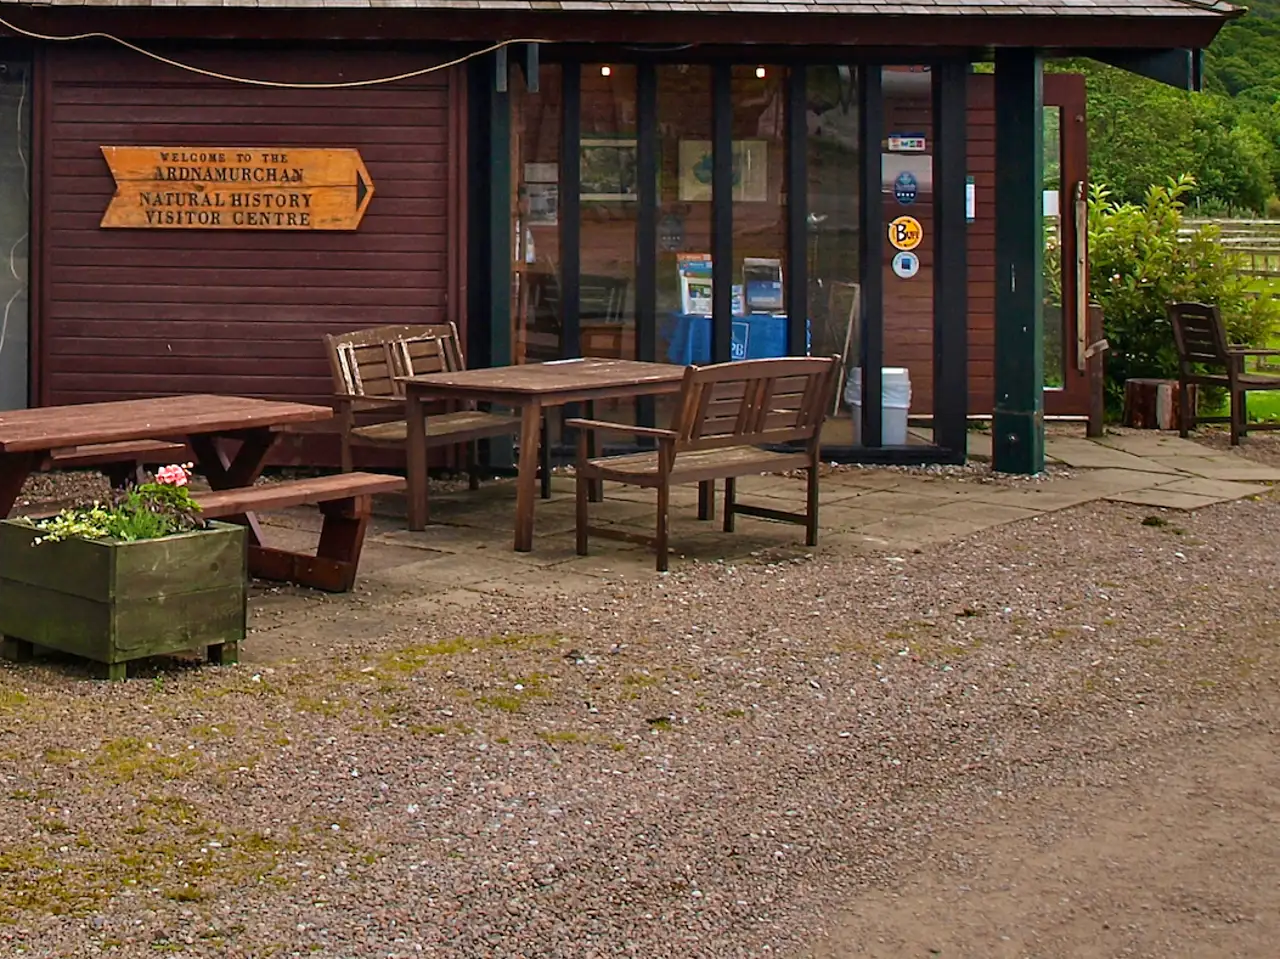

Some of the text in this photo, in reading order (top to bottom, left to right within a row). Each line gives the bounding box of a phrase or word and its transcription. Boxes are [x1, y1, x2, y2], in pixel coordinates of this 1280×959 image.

[160, 152, 288, 163] WELCOME TO THE
[154, 166, 304, 182] ARDNAMURCHAN
[139, 192, 313, 208] NATURAL HISTORY
[145, 210, 311, 226] VISITOR CENTRE
